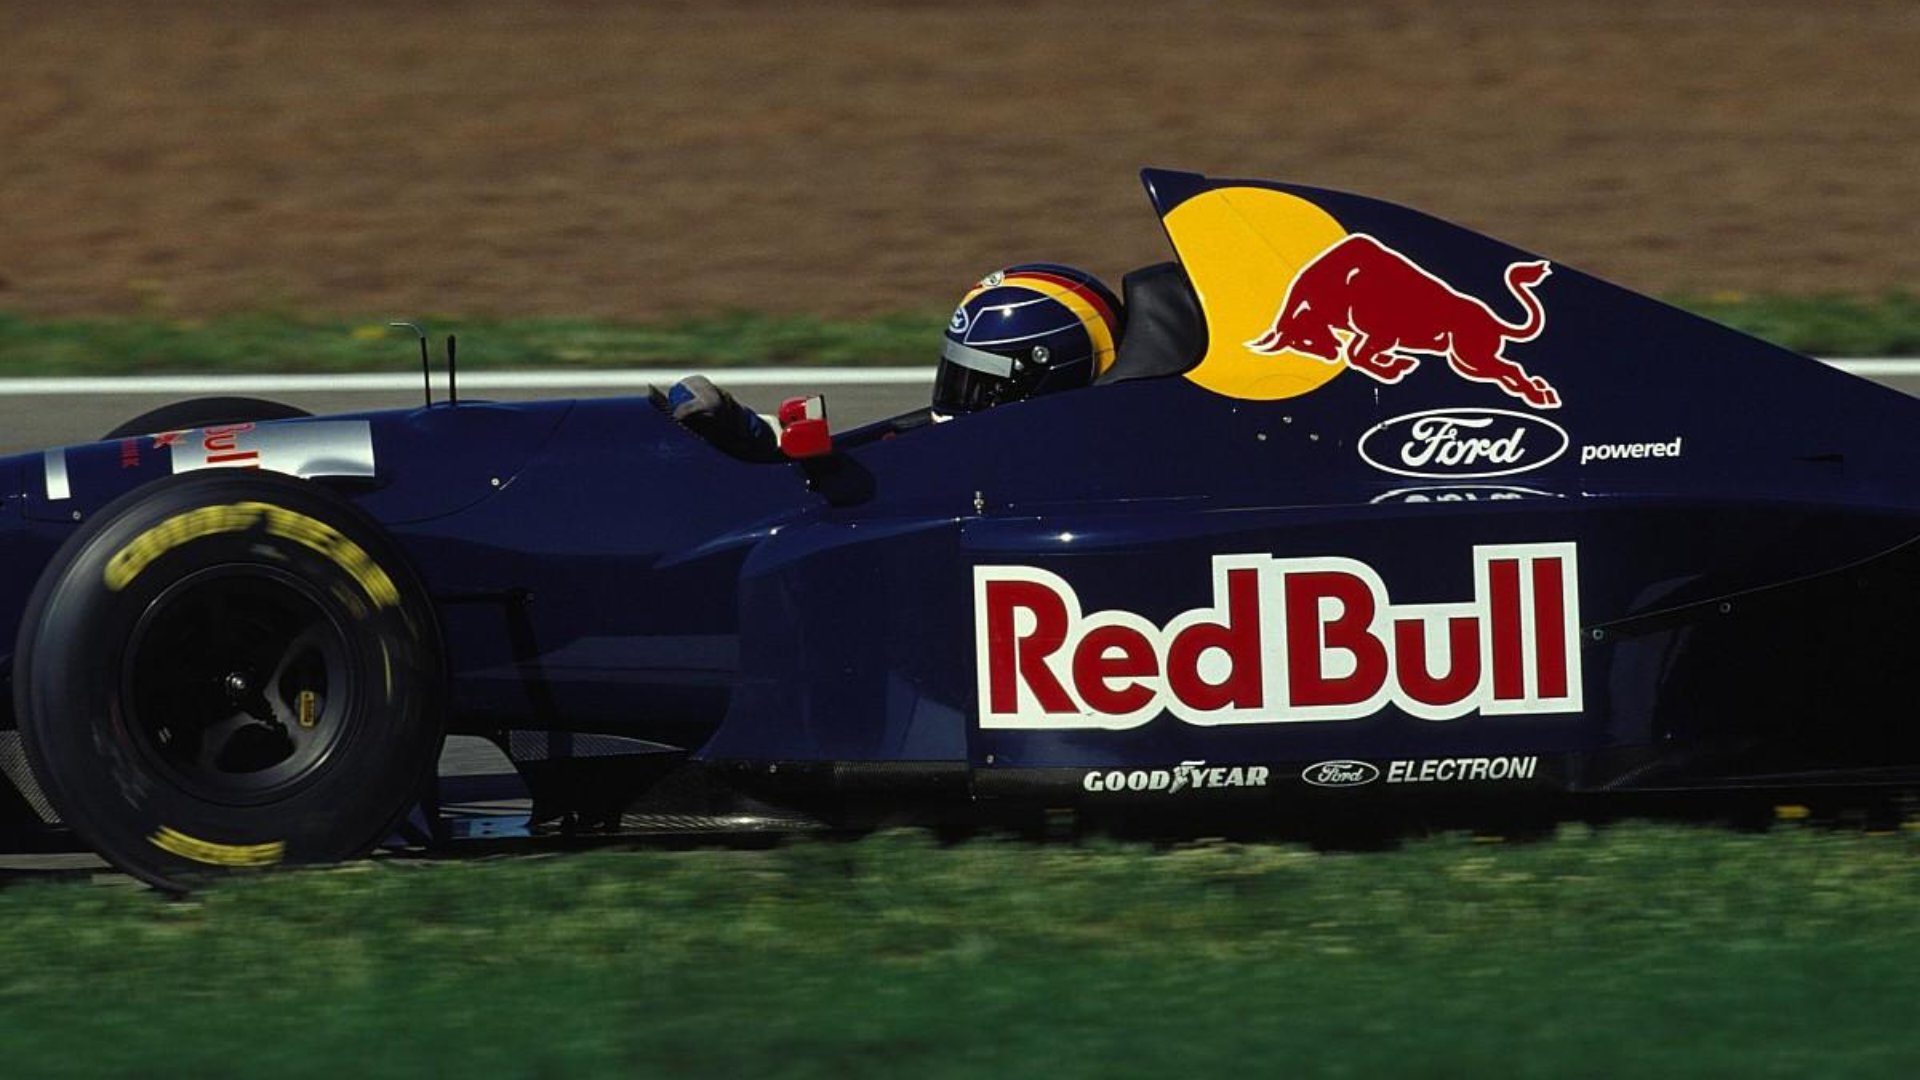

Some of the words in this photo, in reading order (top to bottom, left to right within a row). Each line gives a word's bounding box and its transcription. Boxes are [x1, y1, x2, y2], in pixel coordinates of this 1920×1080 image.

[1400, 415, 1527, 467] Ford
[1580, 437, 1682, 465] powered
[984, 567, 1265, 716] Red
[1283, 556, 1568, 708] Bull
[1316, 763, 1365, 784] Ford
[1386, 756, 1538, 783] ELECTRONI
